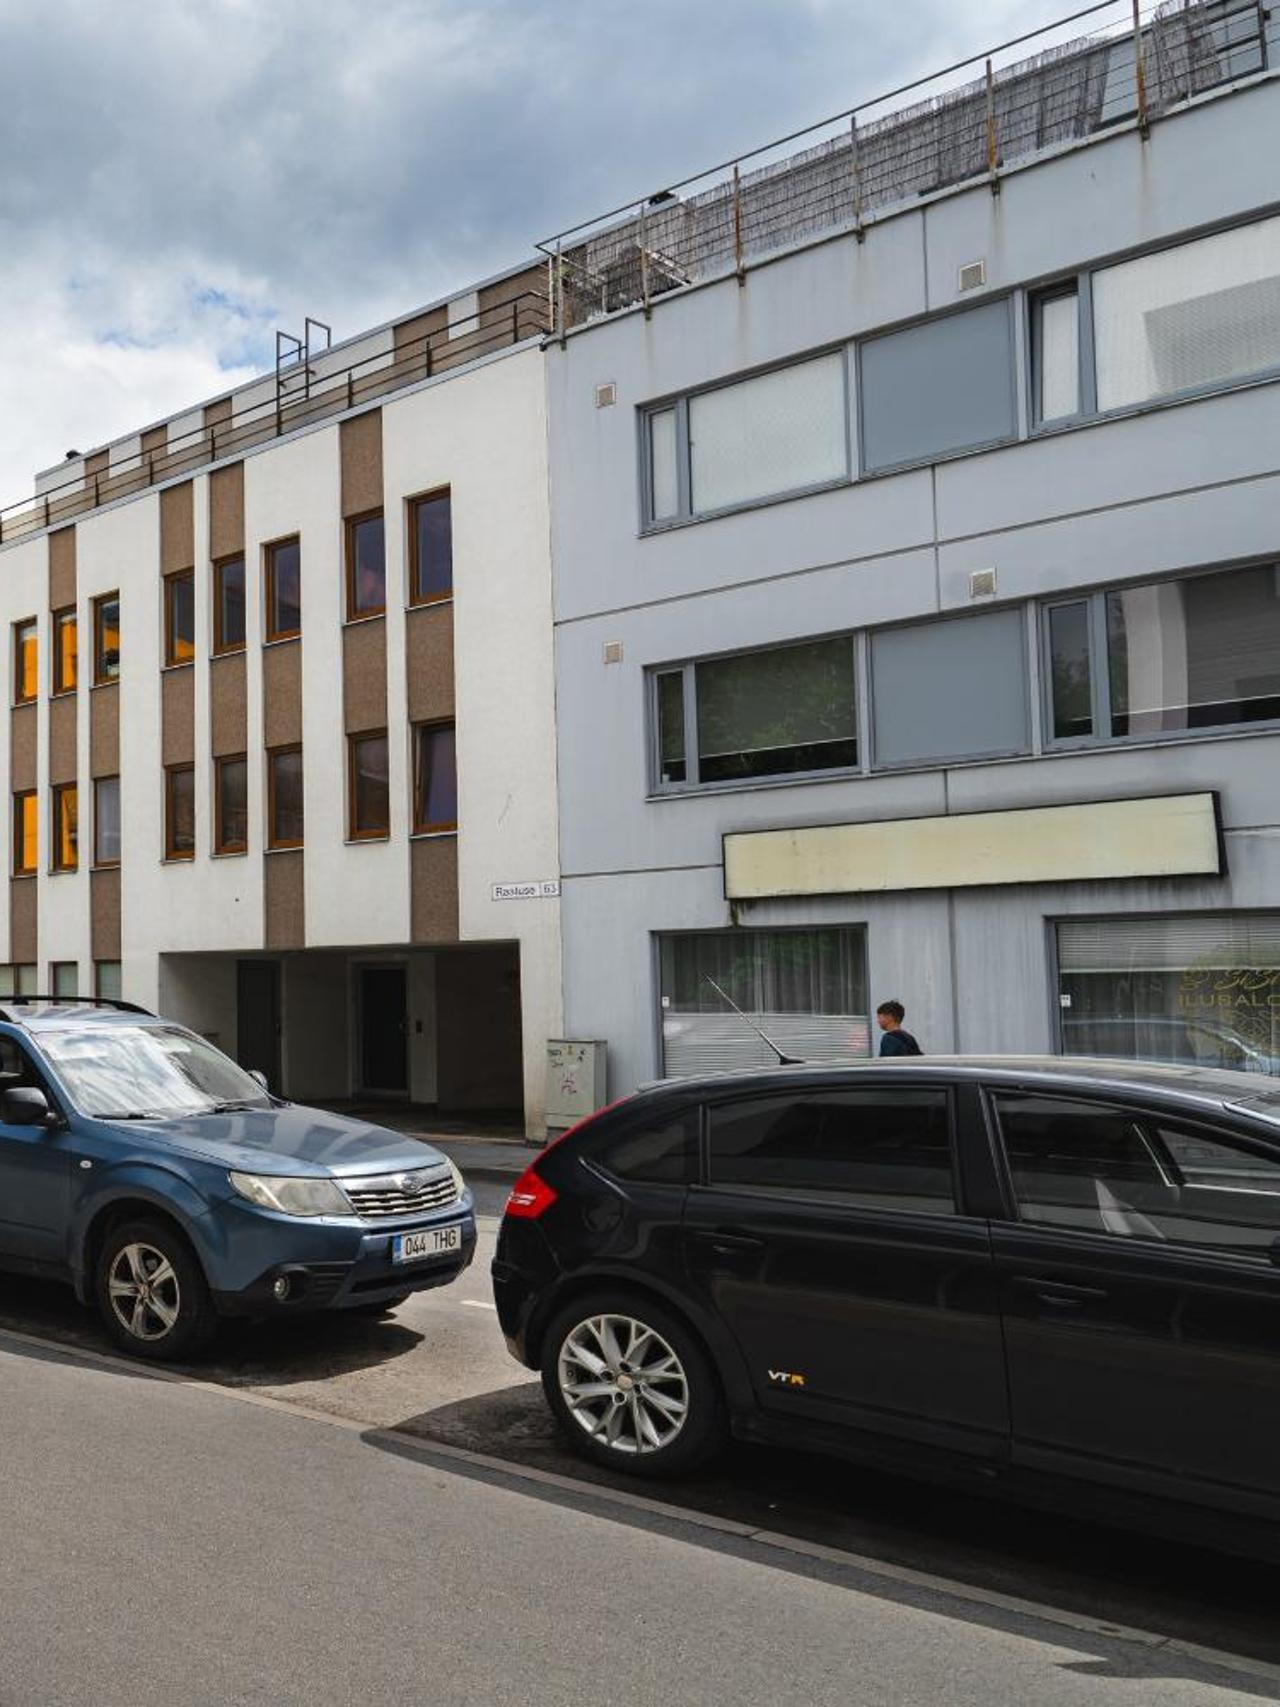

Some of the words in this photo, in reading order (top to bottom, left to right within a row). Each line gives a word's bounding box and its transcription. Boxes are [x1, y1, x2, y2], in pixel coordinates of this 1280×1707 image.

[405, 1236, 426, 1256] 044
[433, 1229, 457, 1249] THG
[767, 1369, 805, 1387] VTR
